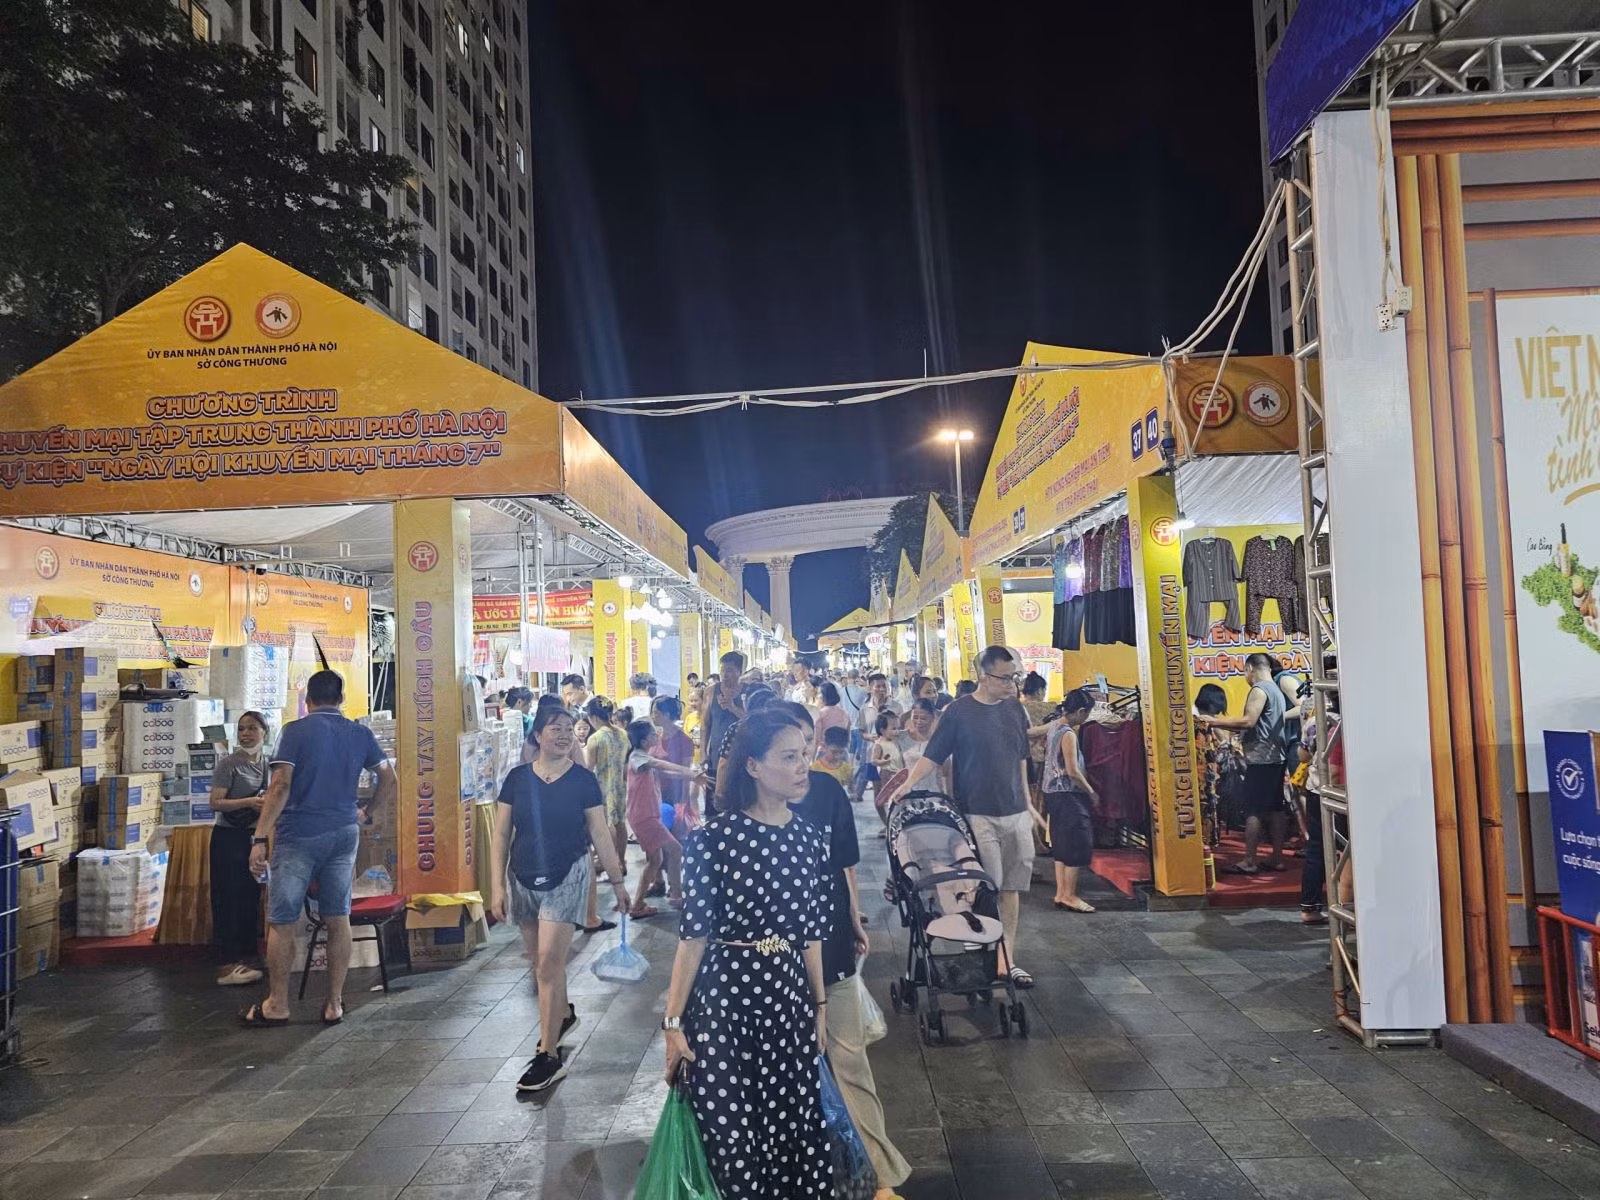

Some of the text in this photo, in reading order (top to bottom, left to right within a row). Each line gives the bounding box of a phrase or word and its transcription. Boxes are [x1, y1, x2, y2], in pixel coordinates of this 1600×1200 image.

[147, 341, 337, 359] ỦY BAN NHÂN DÂN THÀNH PHỐ HÀ NỘI
[197, 357, 287, 369] SỞ CÔNG THƯƠNG
[146, 387, 338, 420] CHƯƠNG TRÌNH
[0, 407, 507, 455] HUYẾN MẠI TẬP TRUNG THÀNH PHỐ HÀ NỘI
[1133, 429, 1142, 452] 37
[1148, 417, 1158, 440] 40
[0, 460, 23, 489] Ự
[23, 457, 85, 488] KIỆN
[173, 450, 221, 481] HỘI
[222, 443, 326, 476] KHUYẾN
[329, 447, 377, 475] MẠI
[379, 440, 467, 468] THÁNG
[81, 560, 94, 569] BAN
[1160, 575, 1181, 616] MẠI
[1159, 619, 1186, 710] KHUYẾN
[412, 658, 434, 723] KÍCH
[143, 719, 174, 728] caboo
[144, 732, 175, 741] caboo
[143, 746, 174, 756] caboo
[416, 725, 435, 777] TAY
[1168, 709, 1191, 773] BỪNG
[142, 759, 173, 769] caboo
[416, 780, 436, 873] CHUNG
